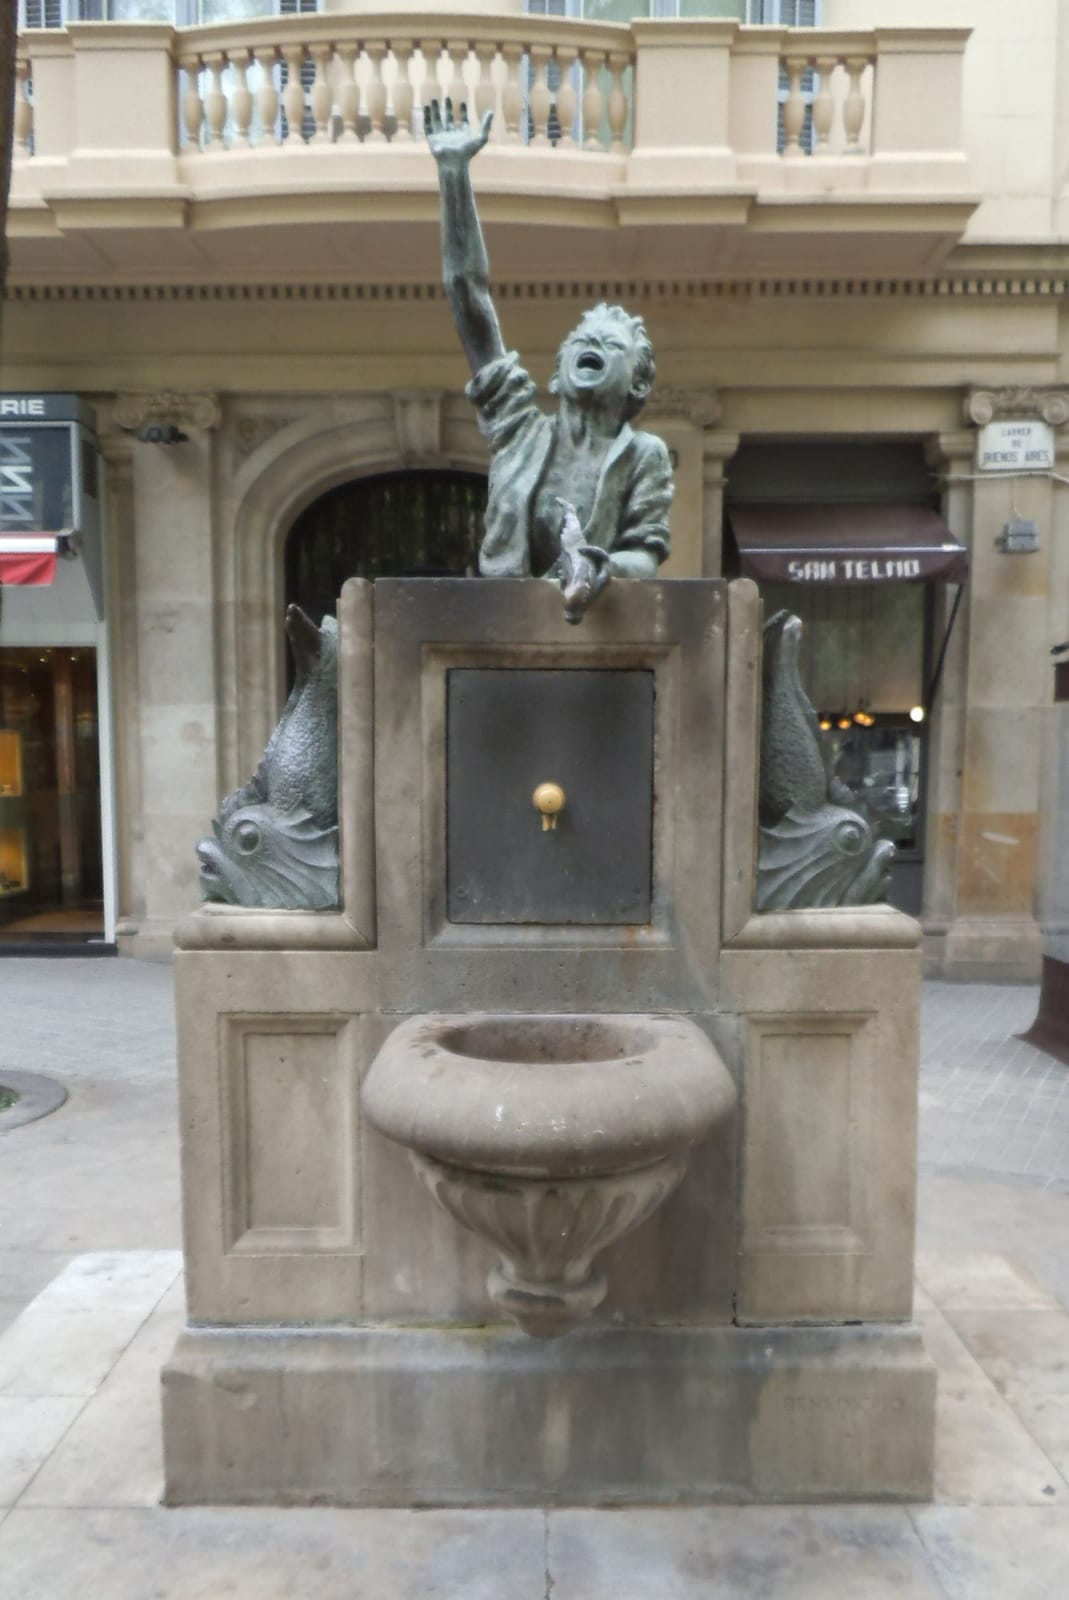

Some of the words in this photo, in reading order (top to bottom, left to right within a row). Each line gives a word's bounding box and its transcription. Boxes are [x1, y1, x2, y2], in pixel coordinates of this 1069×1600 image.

[984, 451, 1017, 463] BUENOS
[1025, 450, 1049, 462] AIRES
[788, 559, 836, 582] SAN
[842, 559, 920, 581] TELMO
